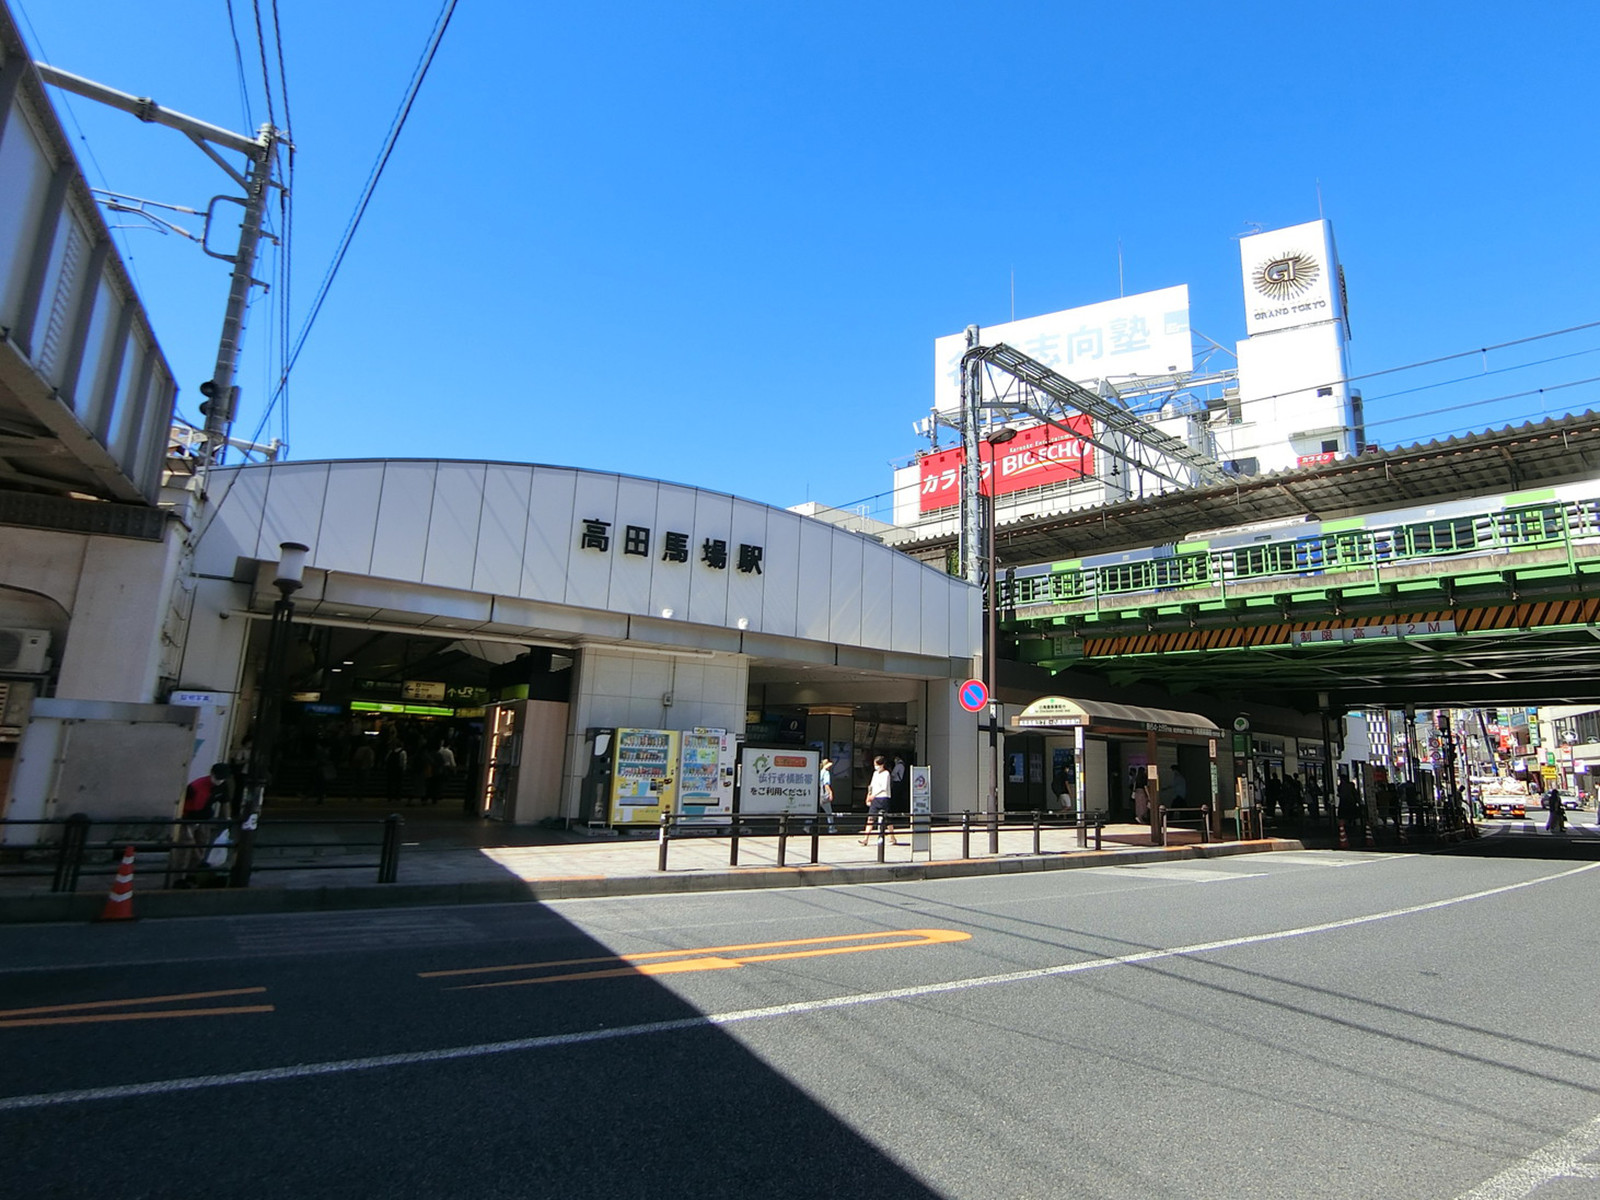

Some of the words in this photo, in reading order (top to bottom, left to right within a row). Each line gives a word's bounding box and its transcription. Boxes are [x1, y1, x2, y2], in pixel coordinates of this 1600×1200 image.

[1254, 307, 1290, 321] GRAND
[1291, 300, 1327, 314] TOKYO
[1002, 451, 1035, 476] BIG
[1038, 438, 1092, 461] ECHO
[581, 518, 764, 575] 高田馬場駅
